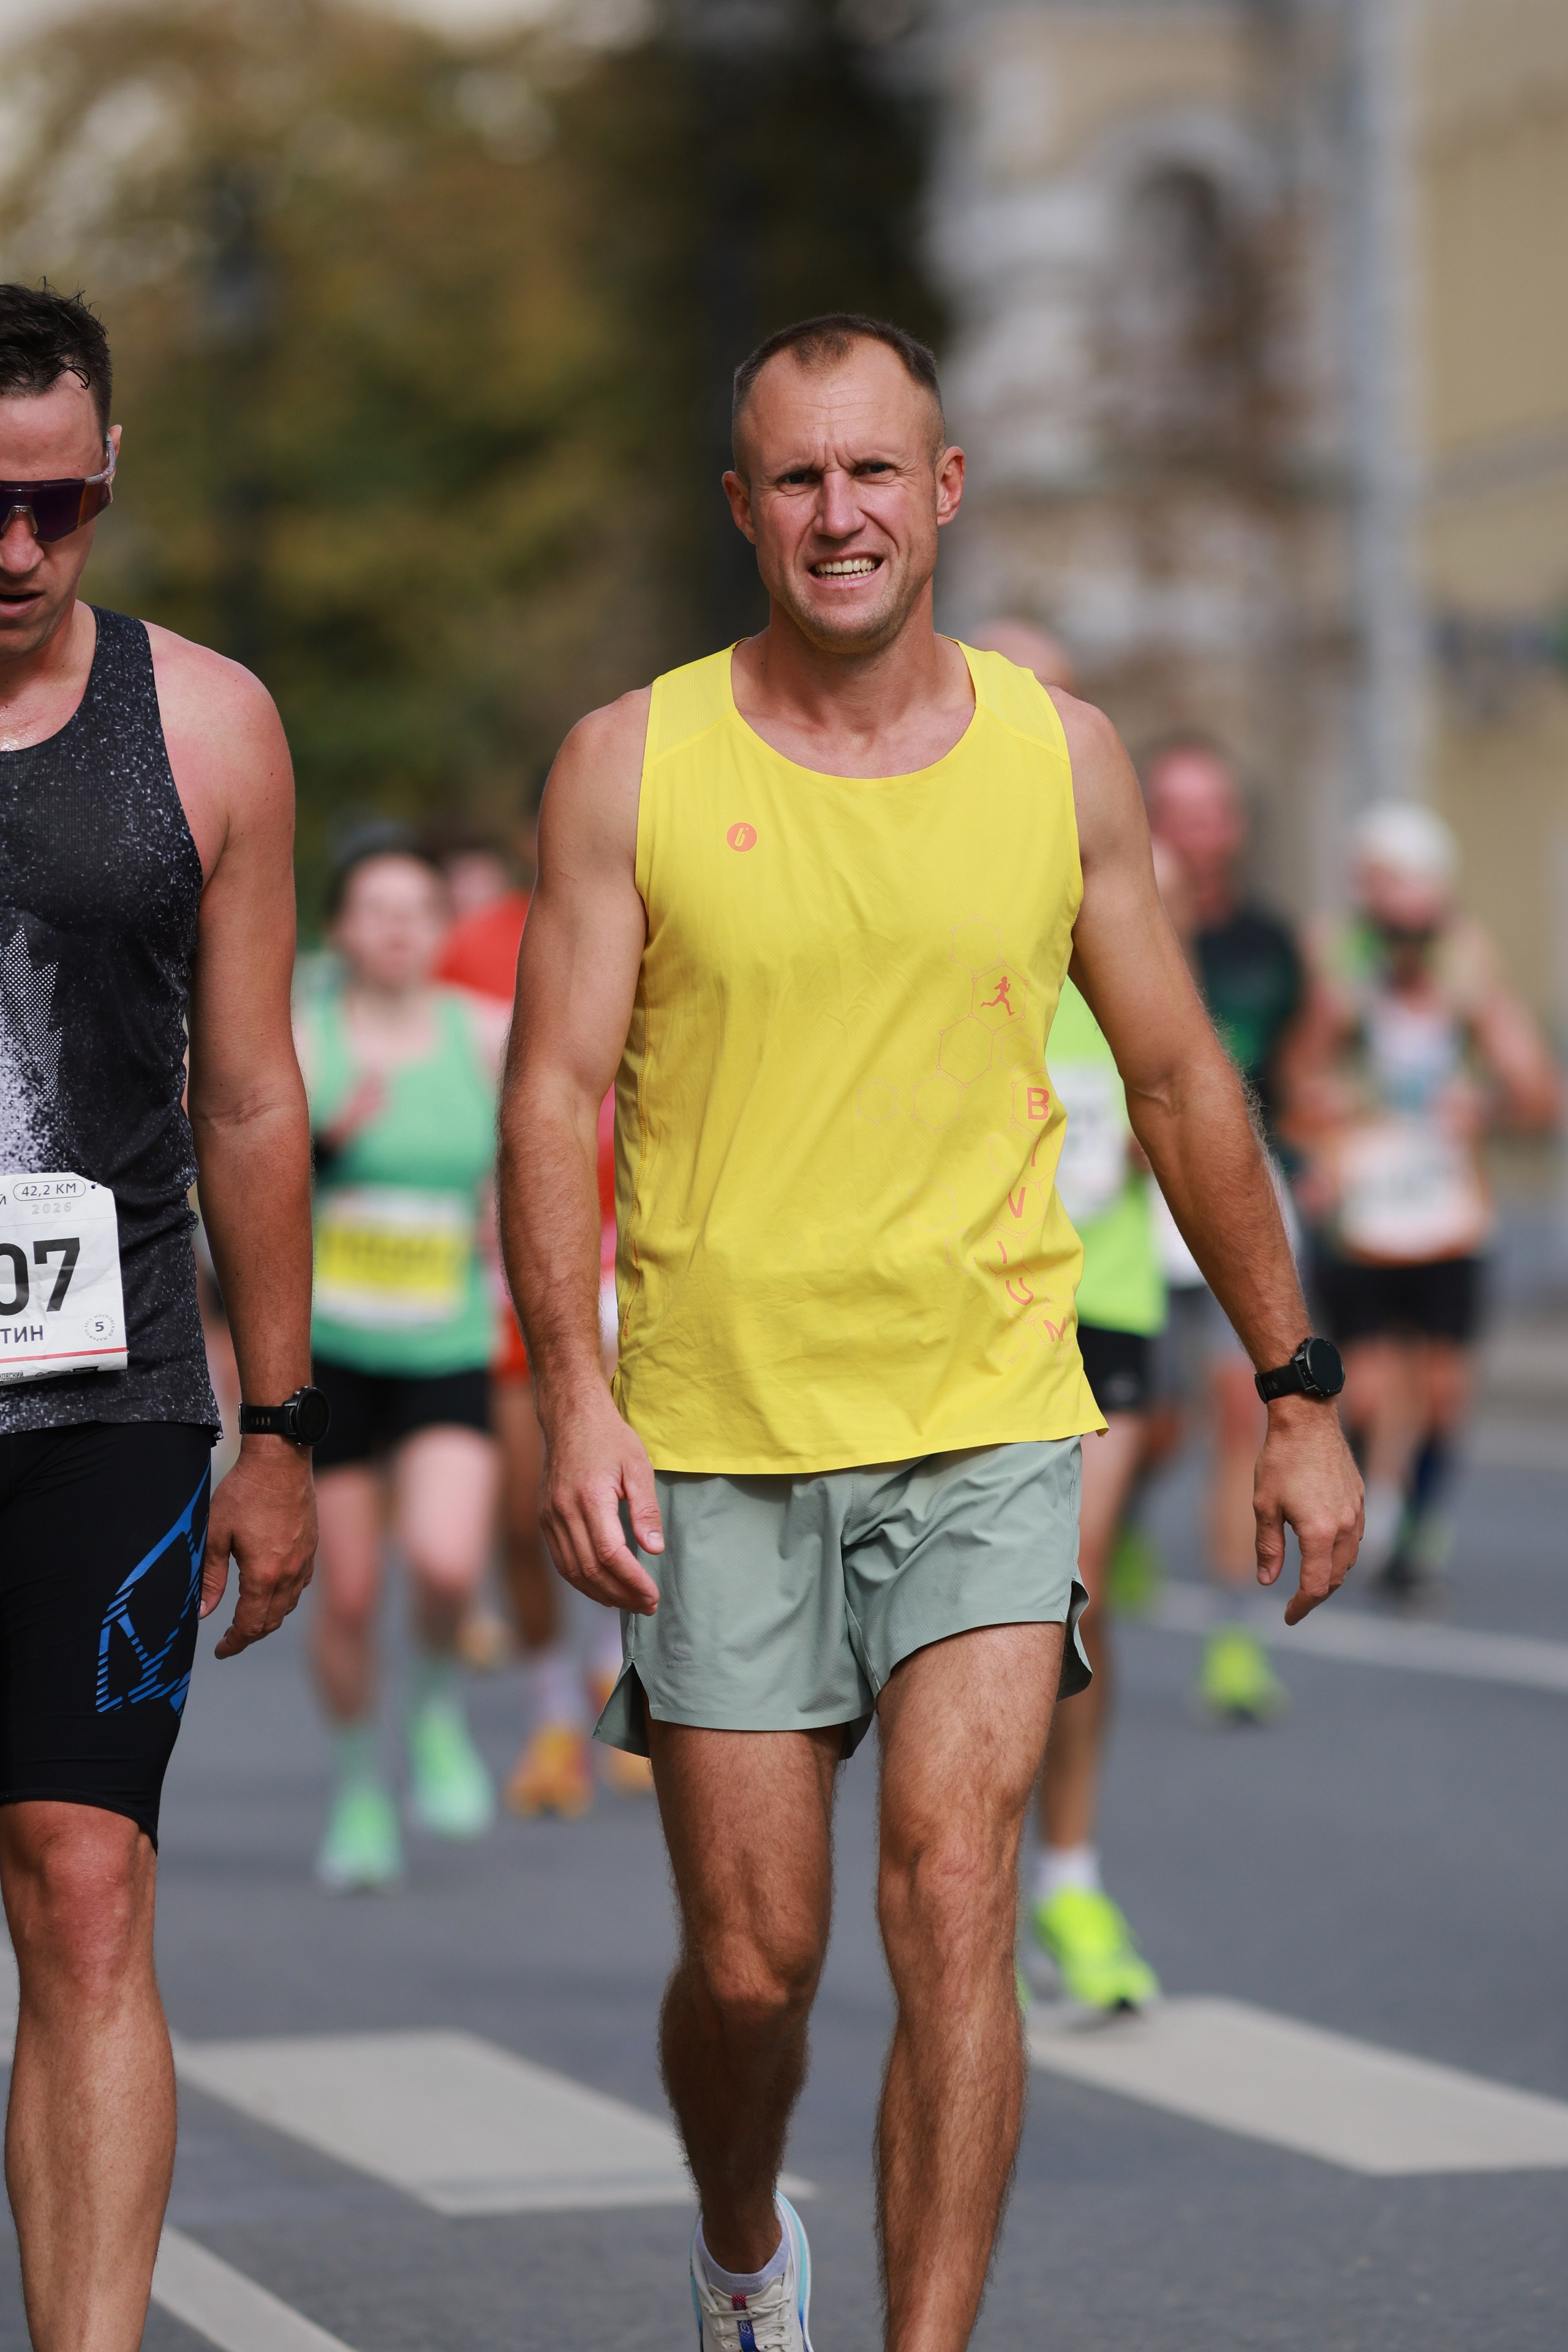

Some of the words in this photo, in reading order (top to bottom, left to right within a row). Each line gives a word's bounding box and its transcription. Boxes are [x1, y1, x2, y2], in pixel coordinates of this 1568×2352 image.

[22, 1185, 50, 1197] 42,2
[32, 1202, 72, 1215] 2026
[95, 1321, 104, 1332] 5
